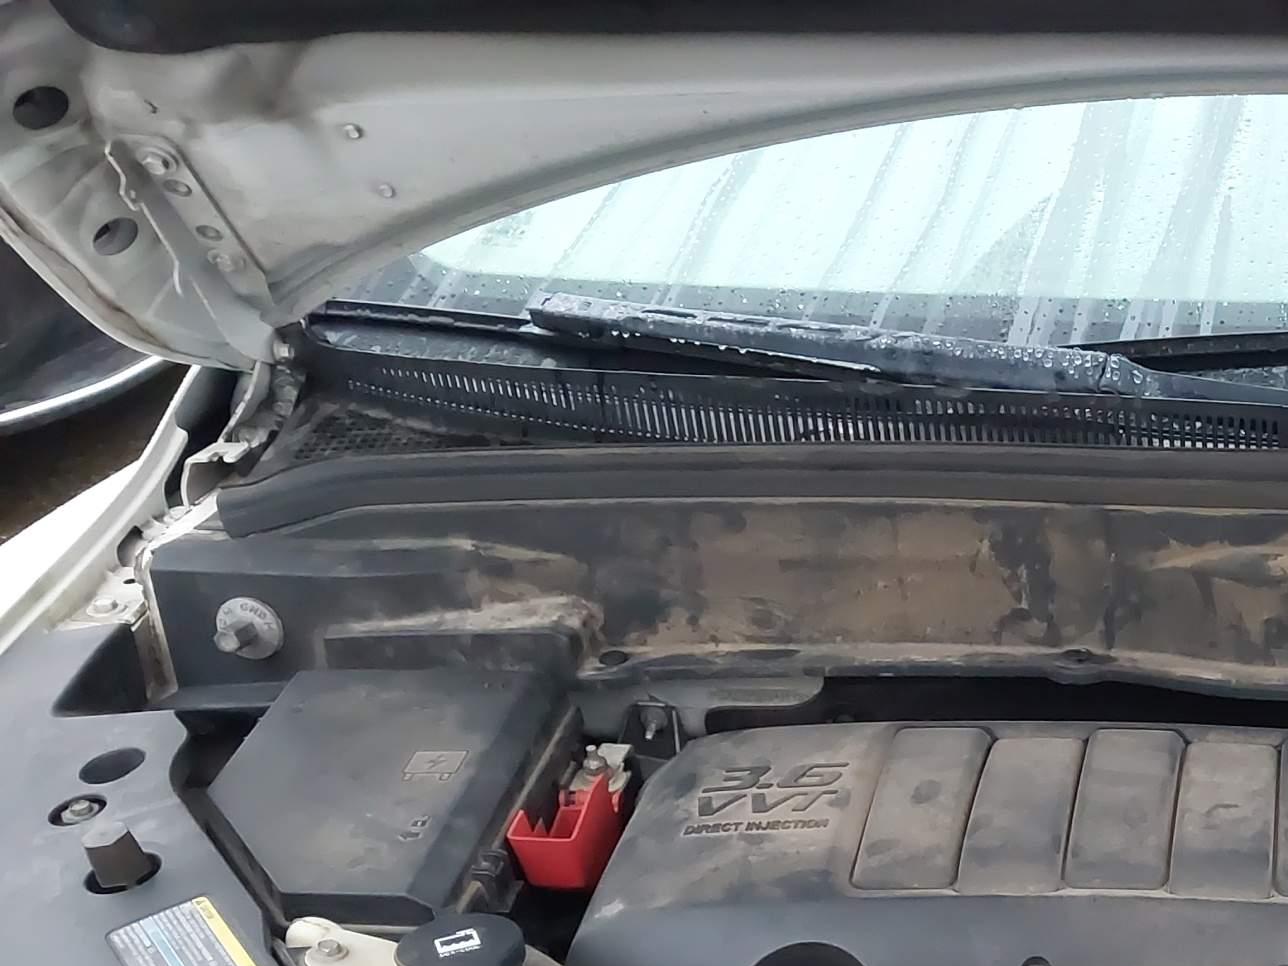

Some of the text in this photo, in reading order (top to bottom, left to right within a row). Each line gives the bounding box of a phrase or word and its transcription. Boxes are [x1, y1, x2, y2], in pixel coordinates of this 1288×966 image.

[701, 761, 850, 794] 3.6
[697, 789, 839, 817] VVT
[683, 818, 829, 836] DIRECT INJECTION
